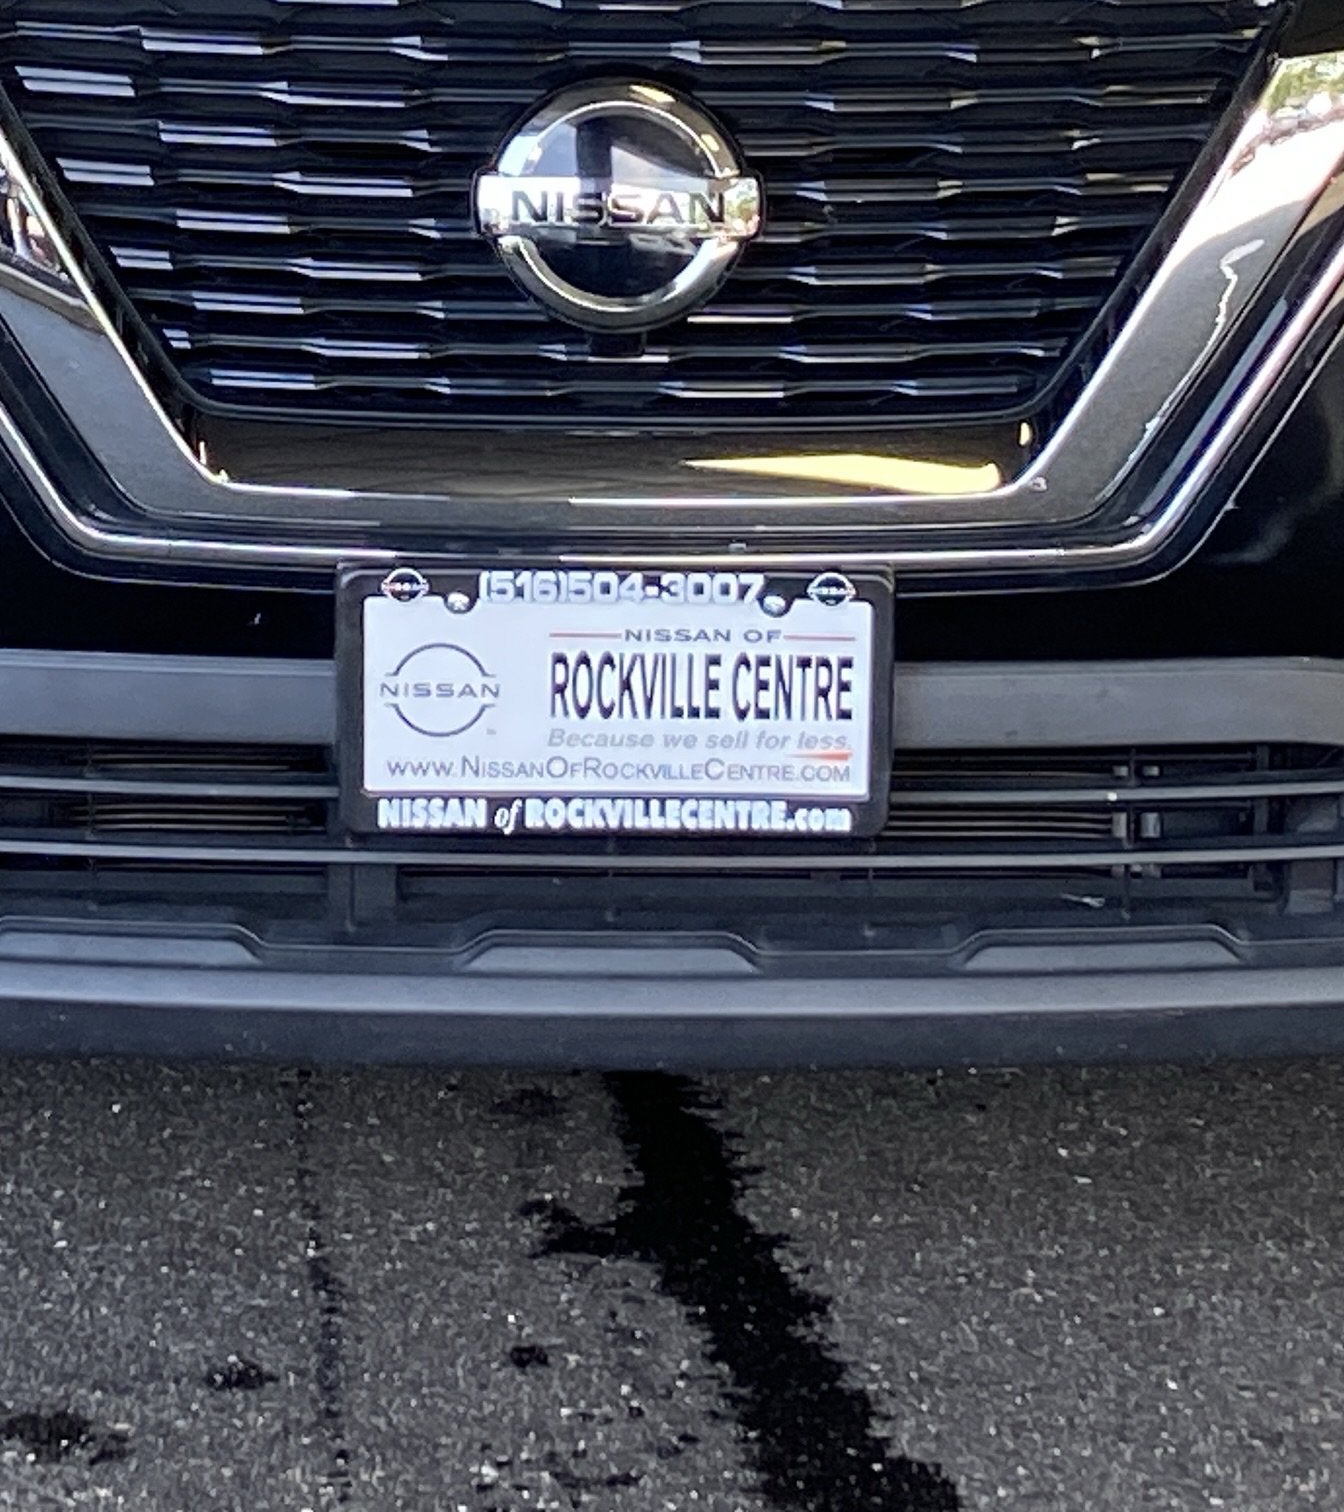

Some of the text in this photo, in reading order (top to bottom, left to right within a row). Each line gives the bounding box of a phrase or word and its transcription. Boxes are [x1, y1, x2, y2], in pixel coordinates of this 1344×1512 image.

[512, 189, 726, 225] NISSAN
[478, 570, 765, 604] (516)504-3007
[624, 628, 783, 644] NISSAN OF
[379, 682, 502, 699] NISSAN
[550, 649, 855, 722] ROCKVILLE CENTRE
[547, 727, 655, 748] Because
[662, 733, 697, 749] we
[705, 729, 749, 750] sell
[755, 730, 791, 750] for
[377, 797, 853, 836] NISSAN of ROCKVILLECENTRE.com
